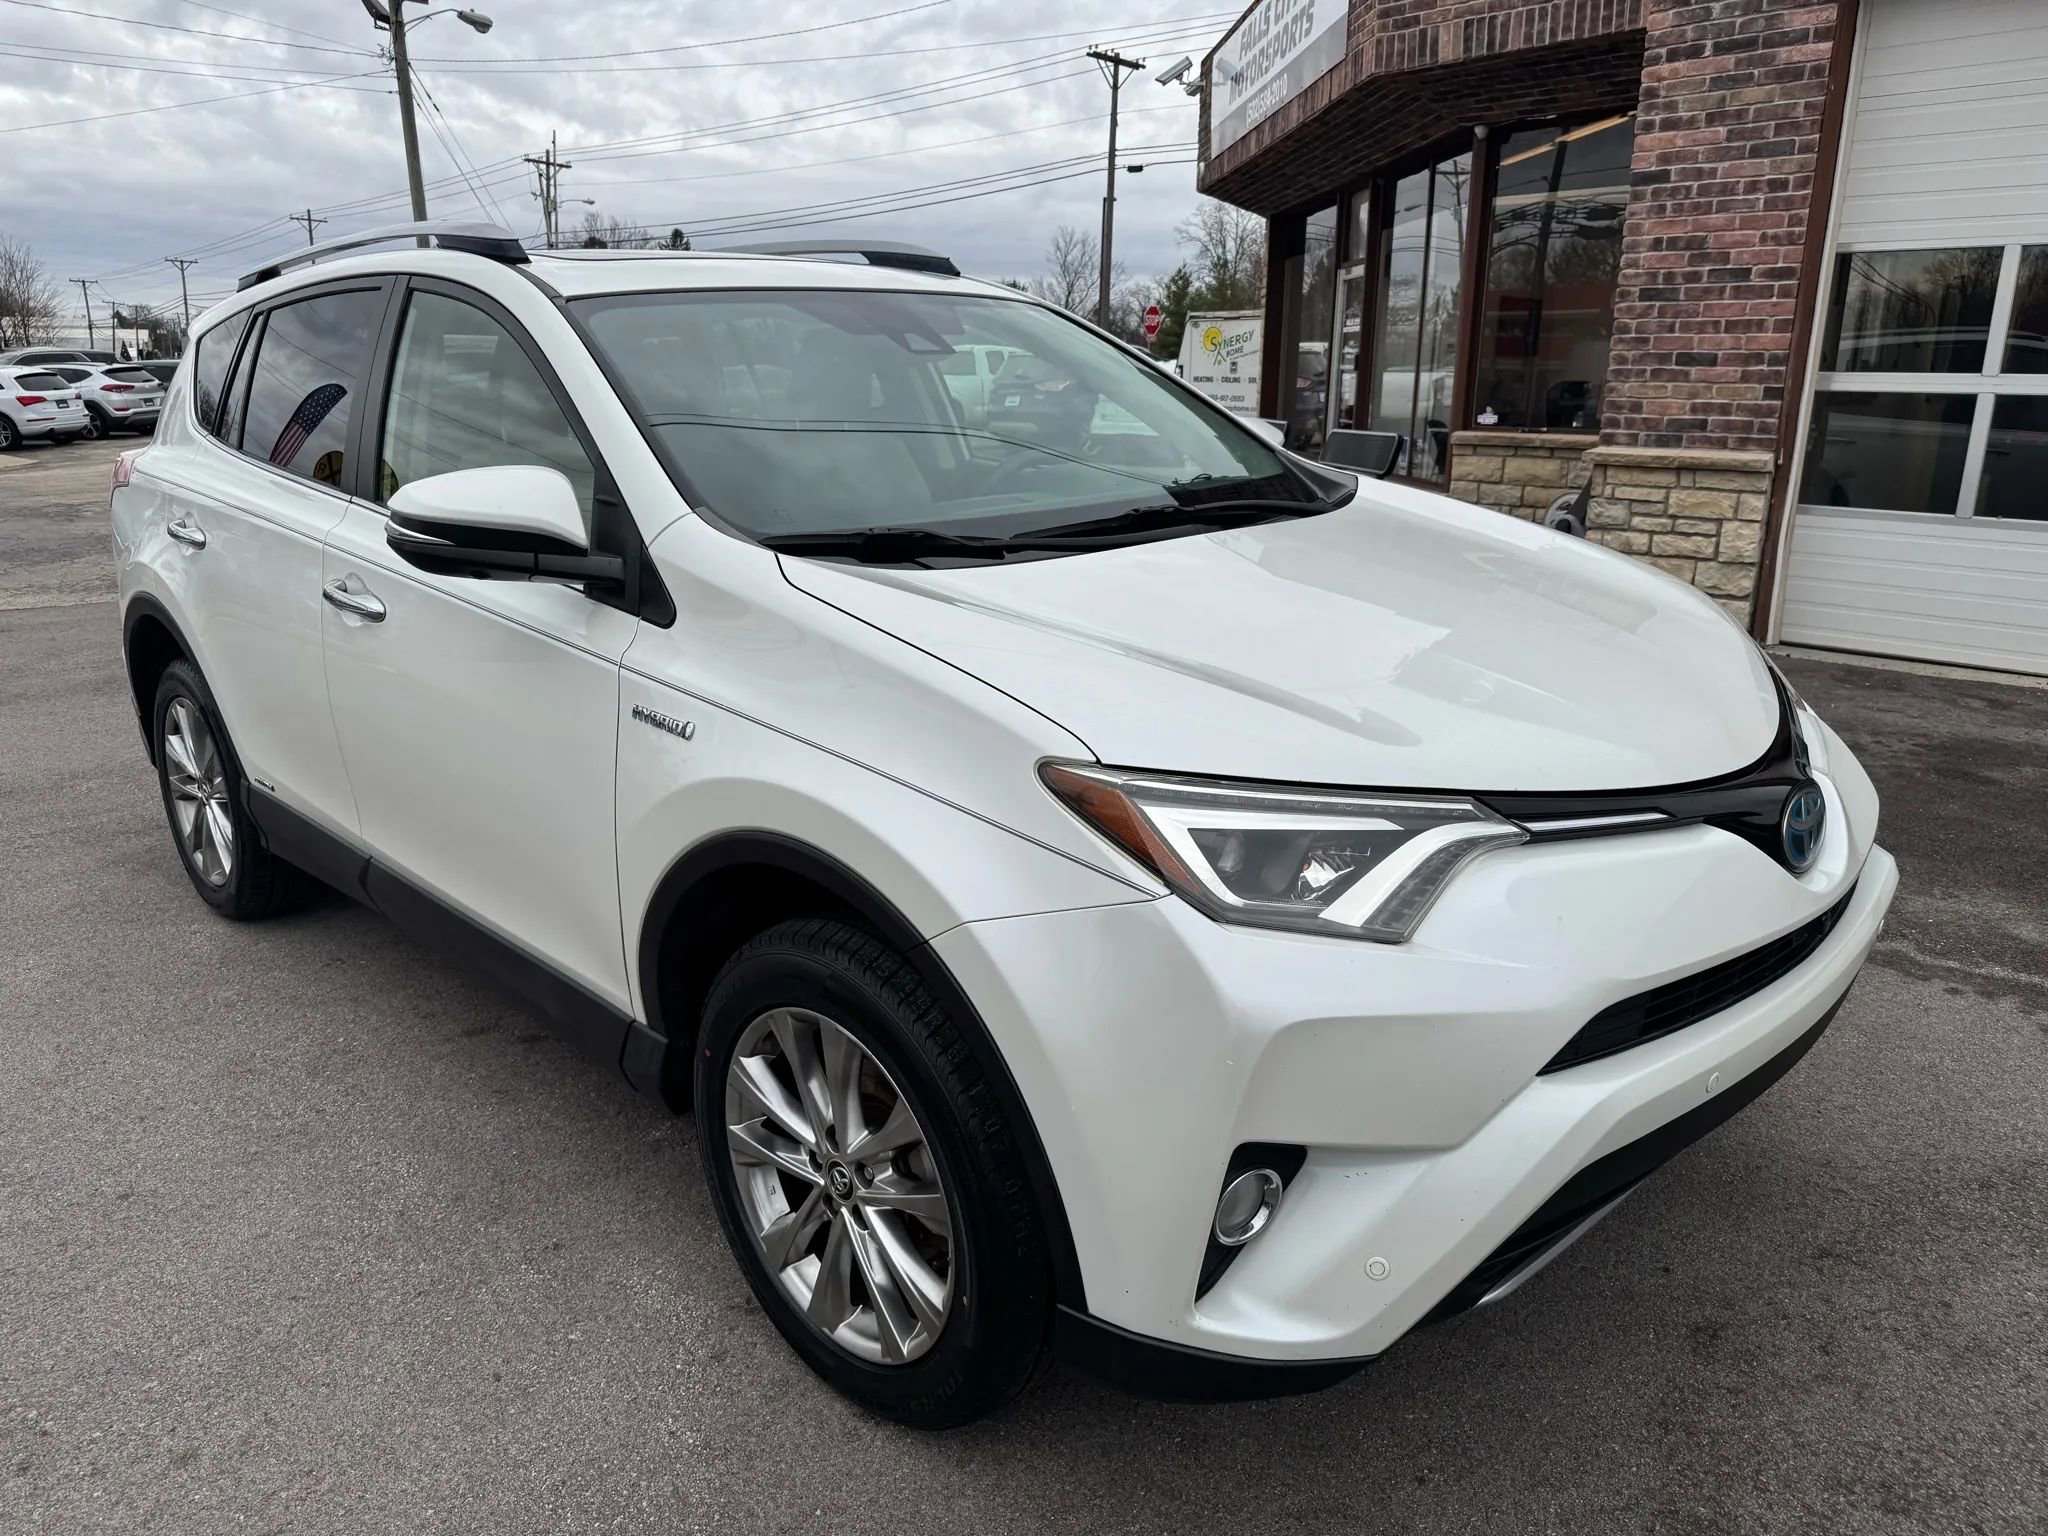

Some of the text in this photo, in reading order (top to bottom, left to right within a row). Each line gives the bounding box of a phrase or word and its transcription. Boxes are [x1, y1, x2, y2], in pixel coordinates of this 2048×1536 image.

[1239, 1, 1271, 62] FALLS
[1229, 0, 1315, 105] MOTORSPORTS
[1145, 314, 1160, 326] STOP
[1210, 329, 1255, 358] SYNERGY
[632, 704, 684, 736] HYBRID
